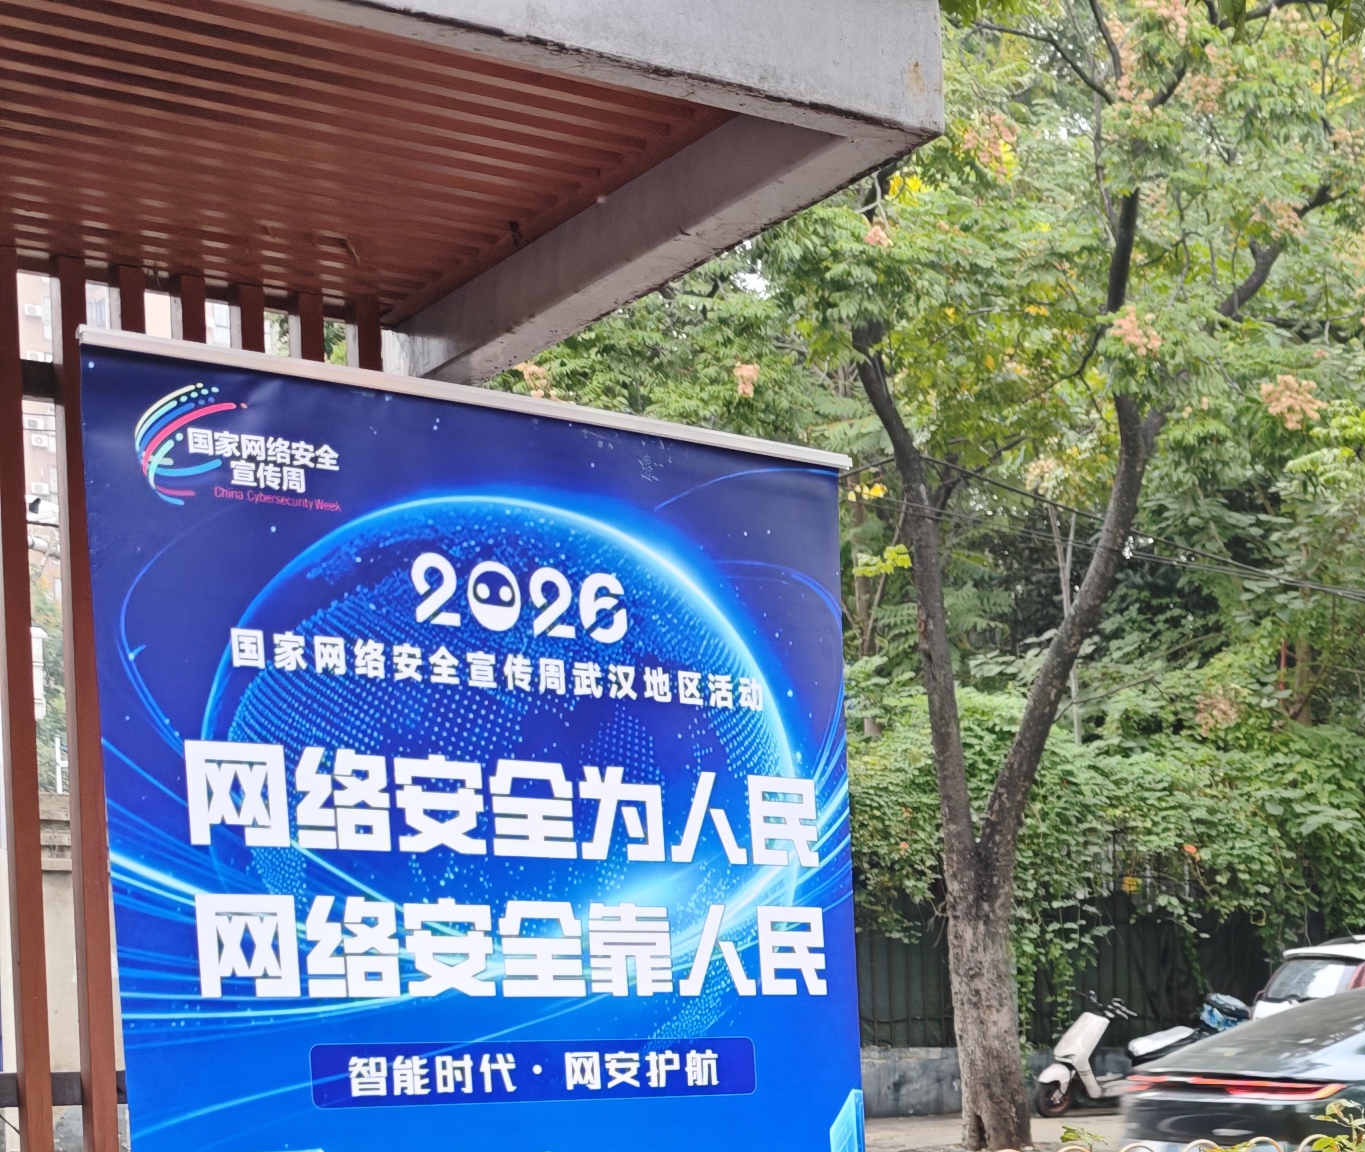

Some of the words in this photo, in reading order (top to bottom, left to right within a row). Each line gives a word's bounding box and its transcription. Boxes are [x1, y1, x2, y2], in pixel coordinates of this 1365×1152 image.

[187, 427, 340, 471] 国家网络安全
[230, 460, 306, 493] 宣传周
[214, 486, 244, 500] China
[247, 489, 314, 511] Cybersecurity
[314, 499, 342, 512] Week
[411, 551, 628, 644] 2026
[231, 628, 765, 713] 国家网络安全宣传周武汉地区活动
[184, 739, 821, 868] 网络安全为人民
[194, 893, 828, 998] 网络安全靠人民
[347, 1049, 720, 1098] 智能时代·网安护航
